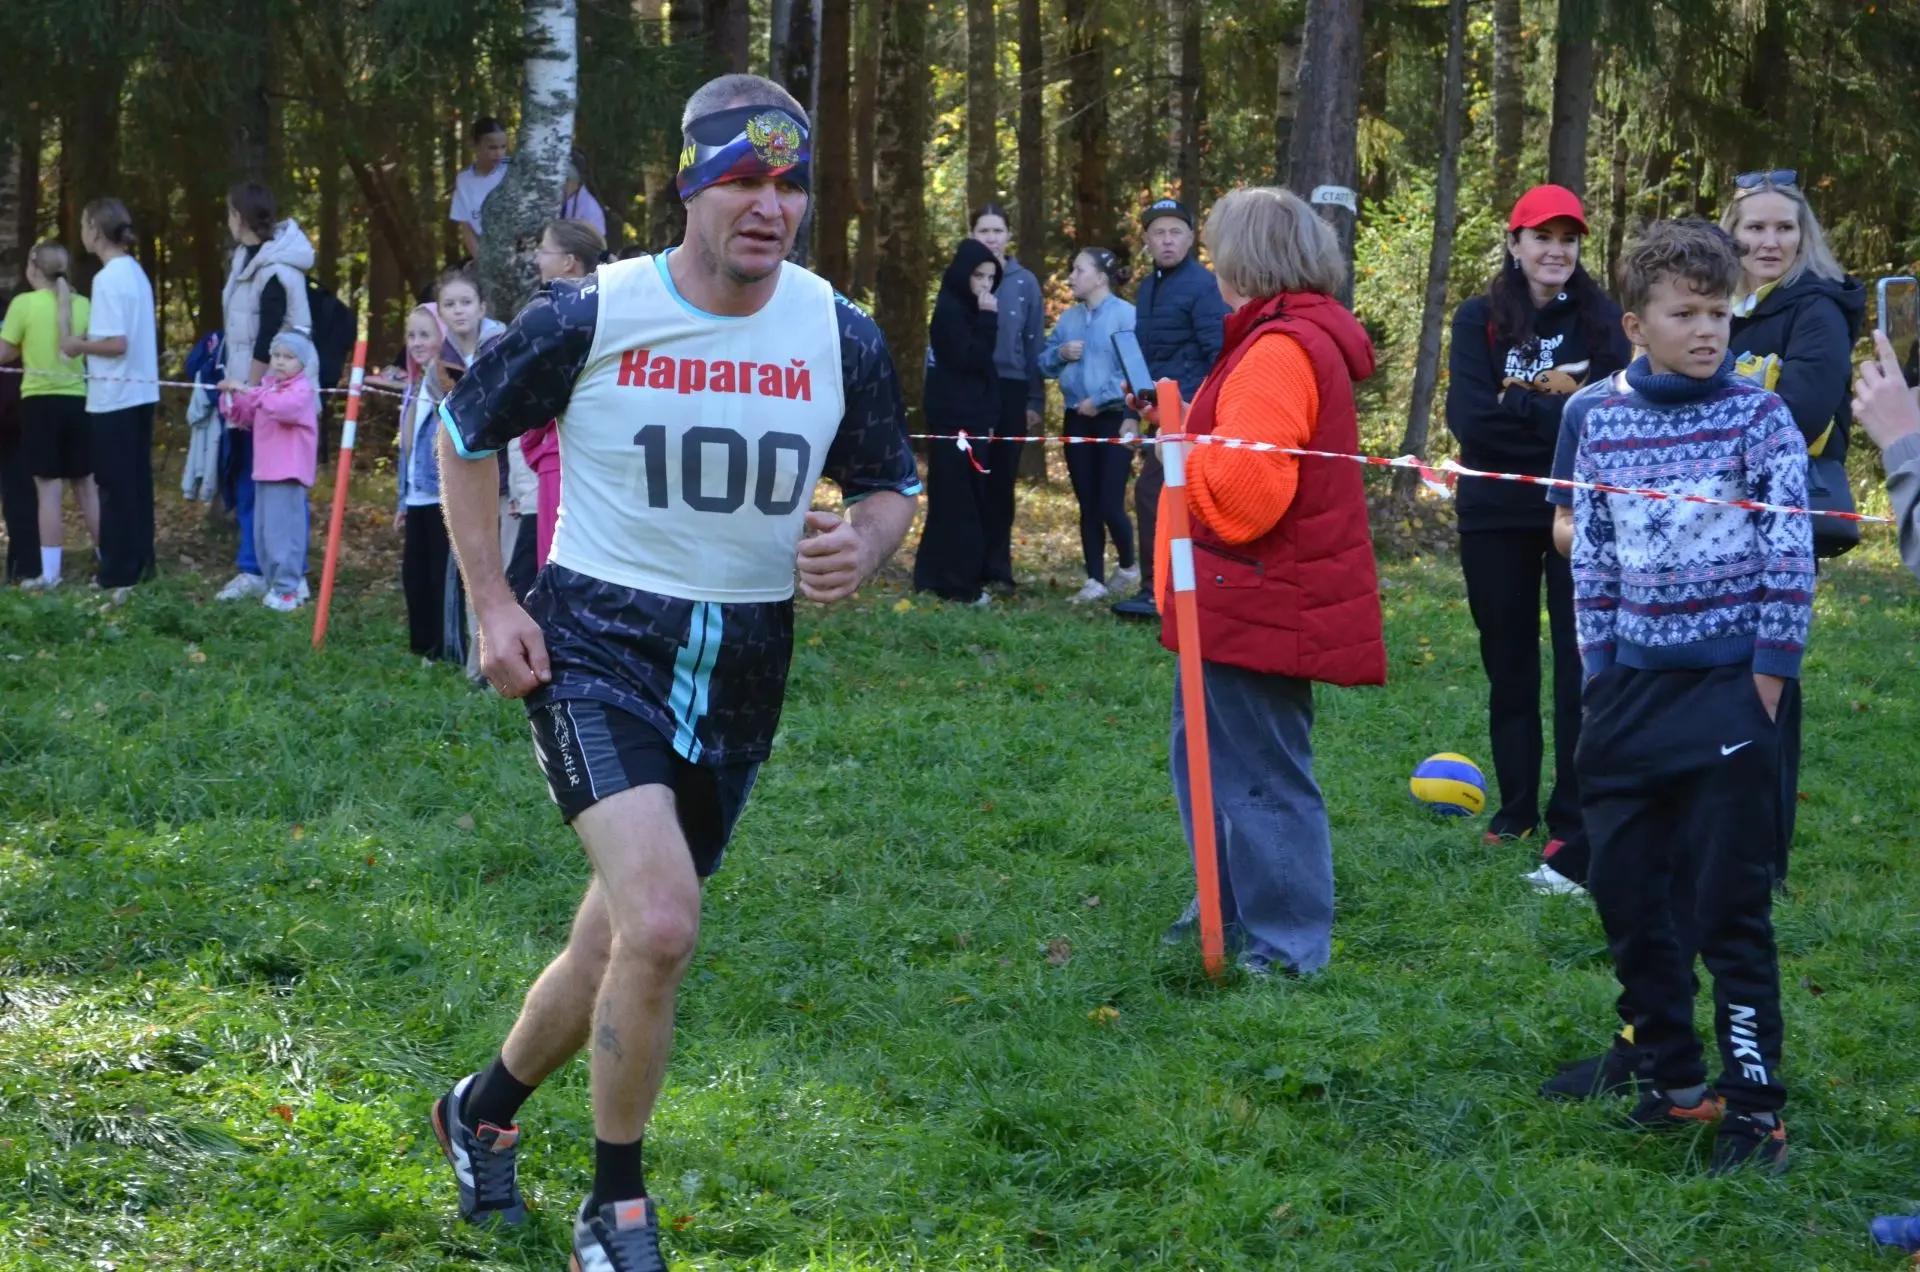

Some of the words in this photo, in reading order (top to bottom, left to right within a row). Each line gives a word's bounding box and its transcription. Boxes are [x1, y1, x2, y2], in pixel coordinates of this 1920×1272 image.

[617, 349, 812, 402] Карагай
[633, 424, 811, 516] 100
[1727, 1003, 1768, 1086] NIKE
